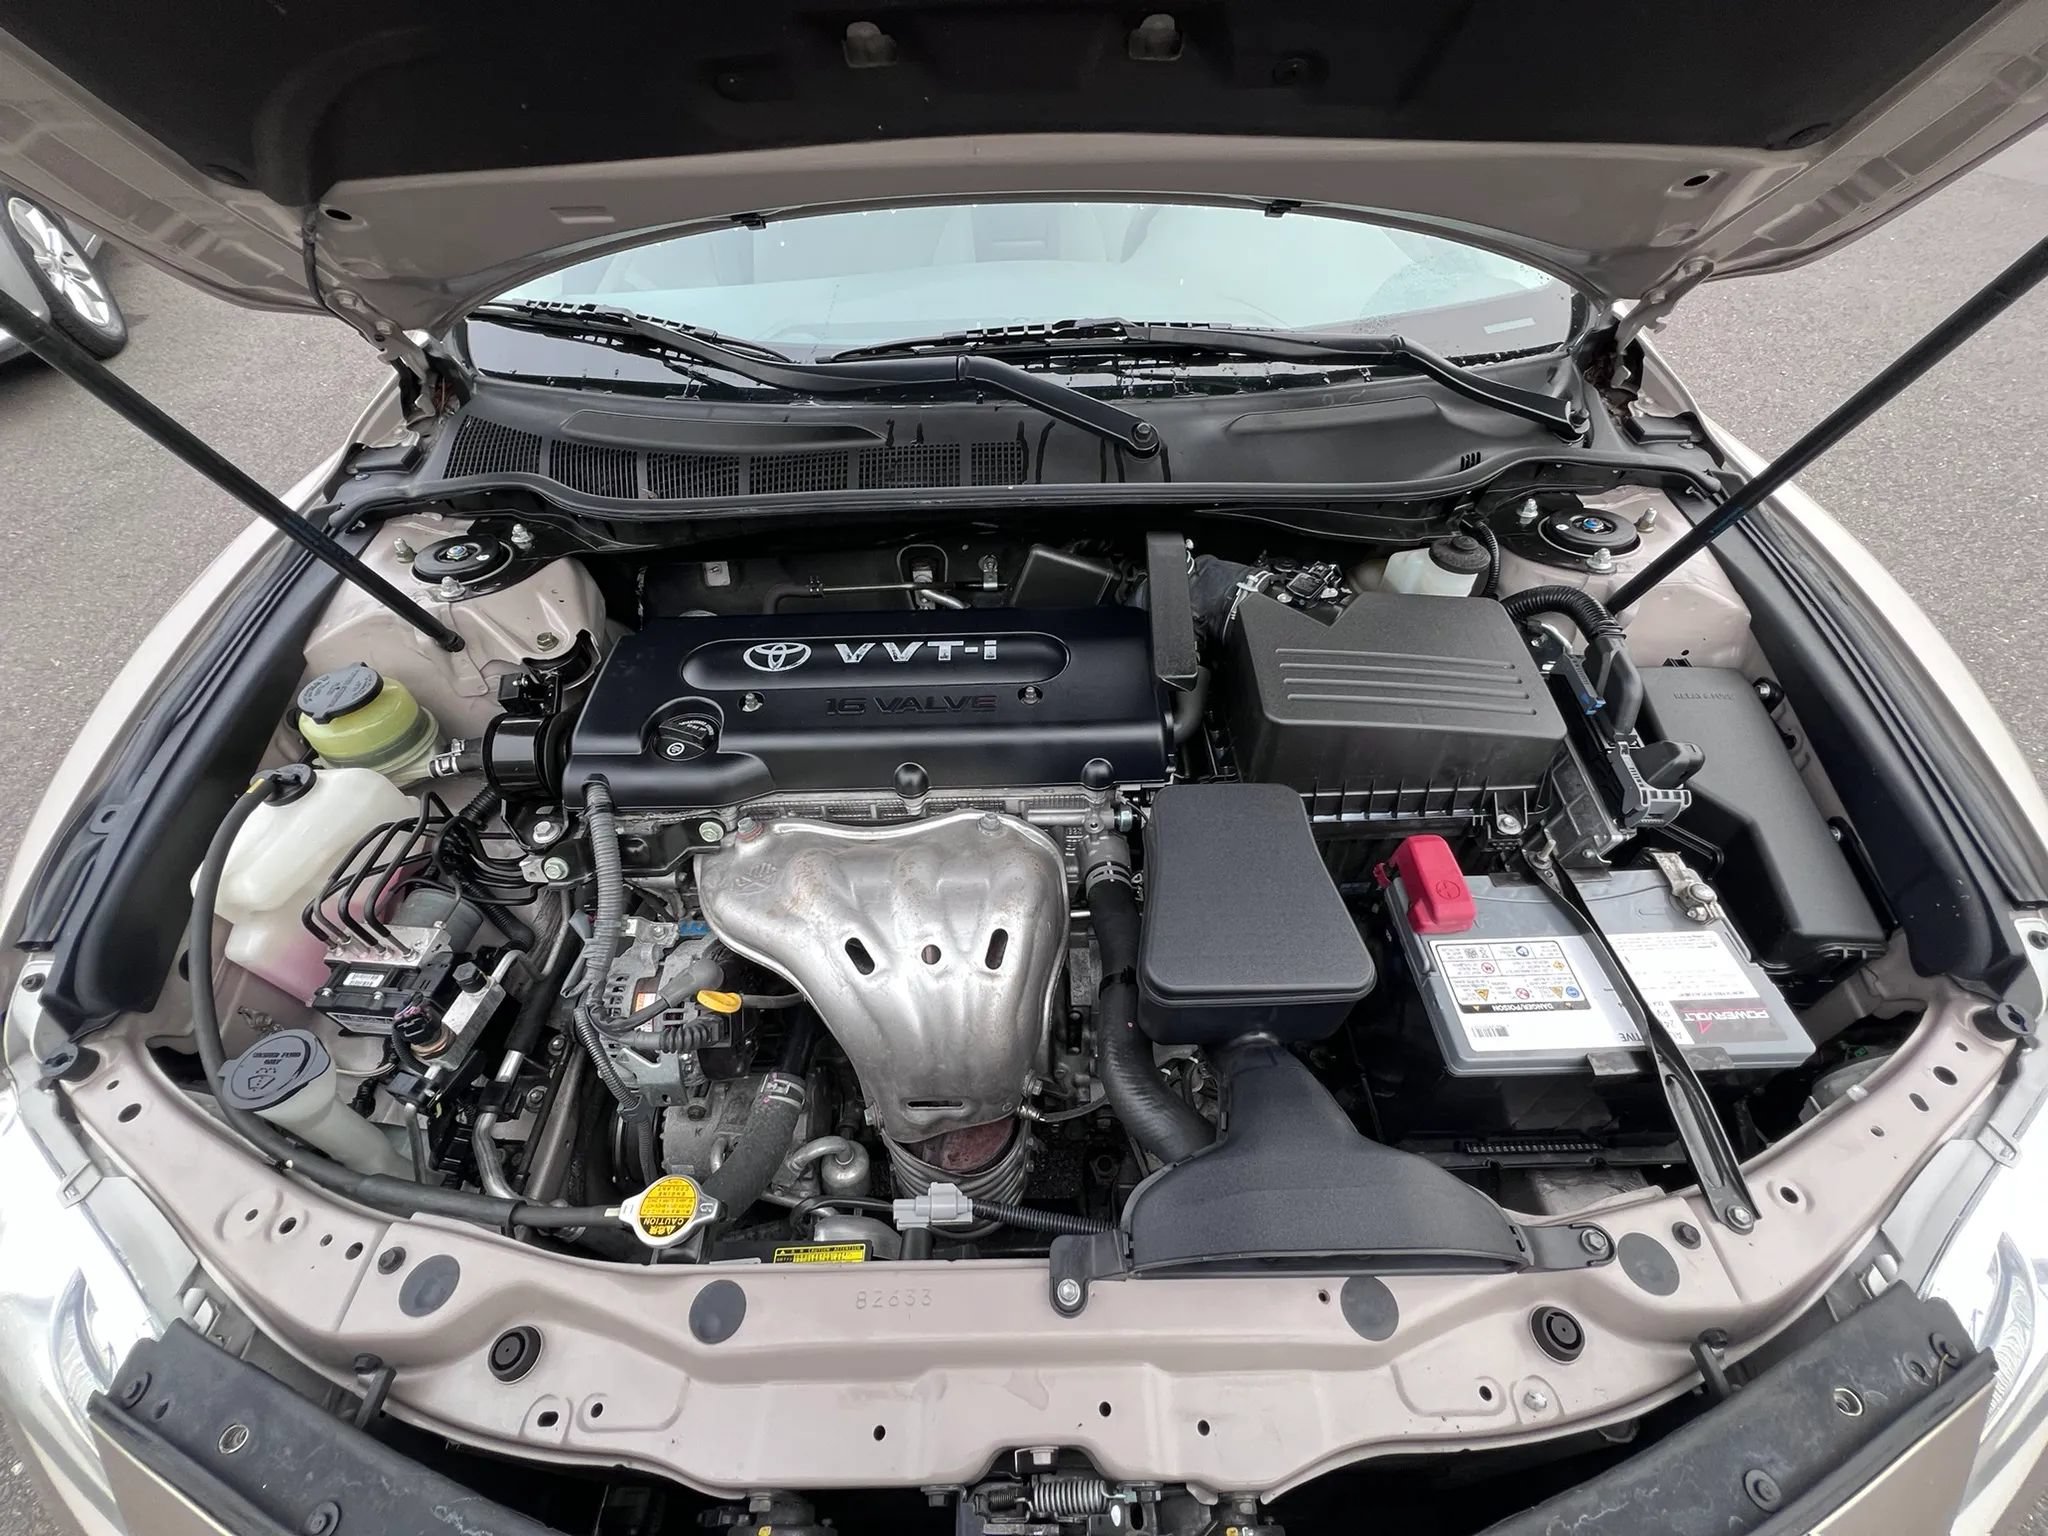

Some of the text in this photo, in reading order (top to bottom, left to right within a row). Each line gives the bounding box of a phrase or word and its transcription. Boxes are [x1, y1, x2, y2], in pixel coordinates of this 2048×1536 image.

[834, 639, 997, 664] VVT-i
[825, 695, 998, 716] 16 VALVE
[1683, 1009, 1770, 1022] POWERVOLT
[643, 1217, 685, 1225] CAUTION
[855, 1288, 933, 1310] 82633
